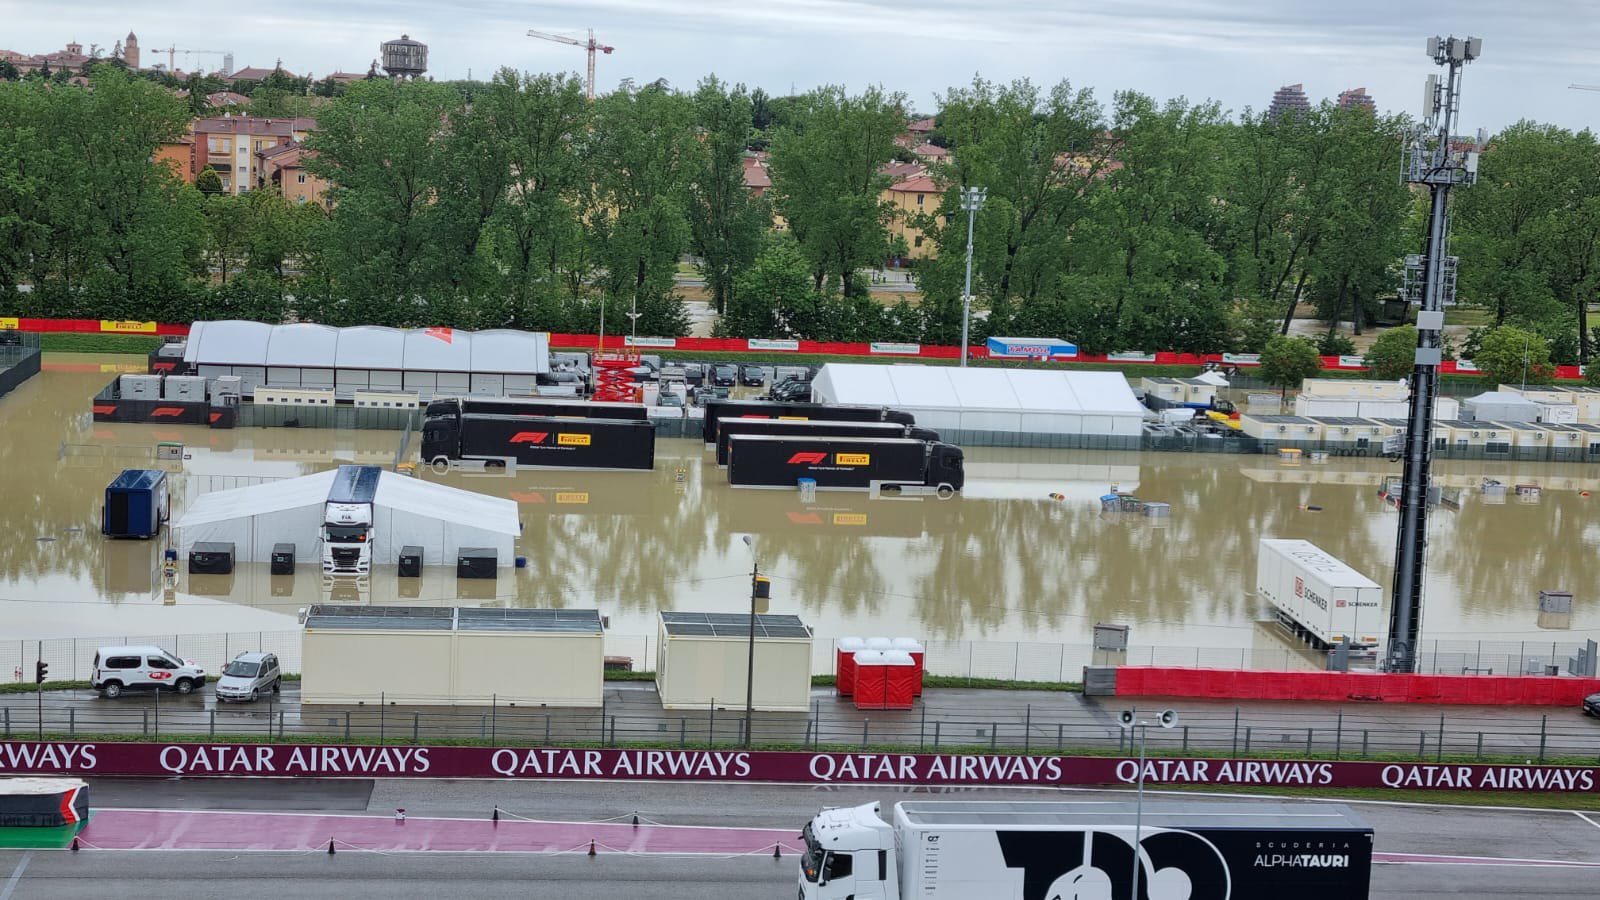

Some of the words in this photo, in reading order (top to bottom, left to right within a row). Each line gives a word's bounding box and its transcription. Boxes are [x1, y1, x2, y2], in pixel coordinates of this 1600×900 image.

[1304, 587, 1328, 612] SCHENKER
[160, 747, 276, 773] QATAR
[286, 748, 430, 772] AIRWAYS
[491, 749, 602, 776] QATAR
[612, 751, 757, 777] AIRWAYS
[809, 754, 918, 781] QATAR
[926, 756, 1062, 780] AIRWAYS
[1116, 760, 1209, 784] QATAR
[1216, 761, 1333, 784] AIRWAYS
[1381, 765, 1472, 788] QATAR
[1480, 767, 1597, 790] AIRWAYS
[1253, 854, 1349, 868] ALPHATAURI
